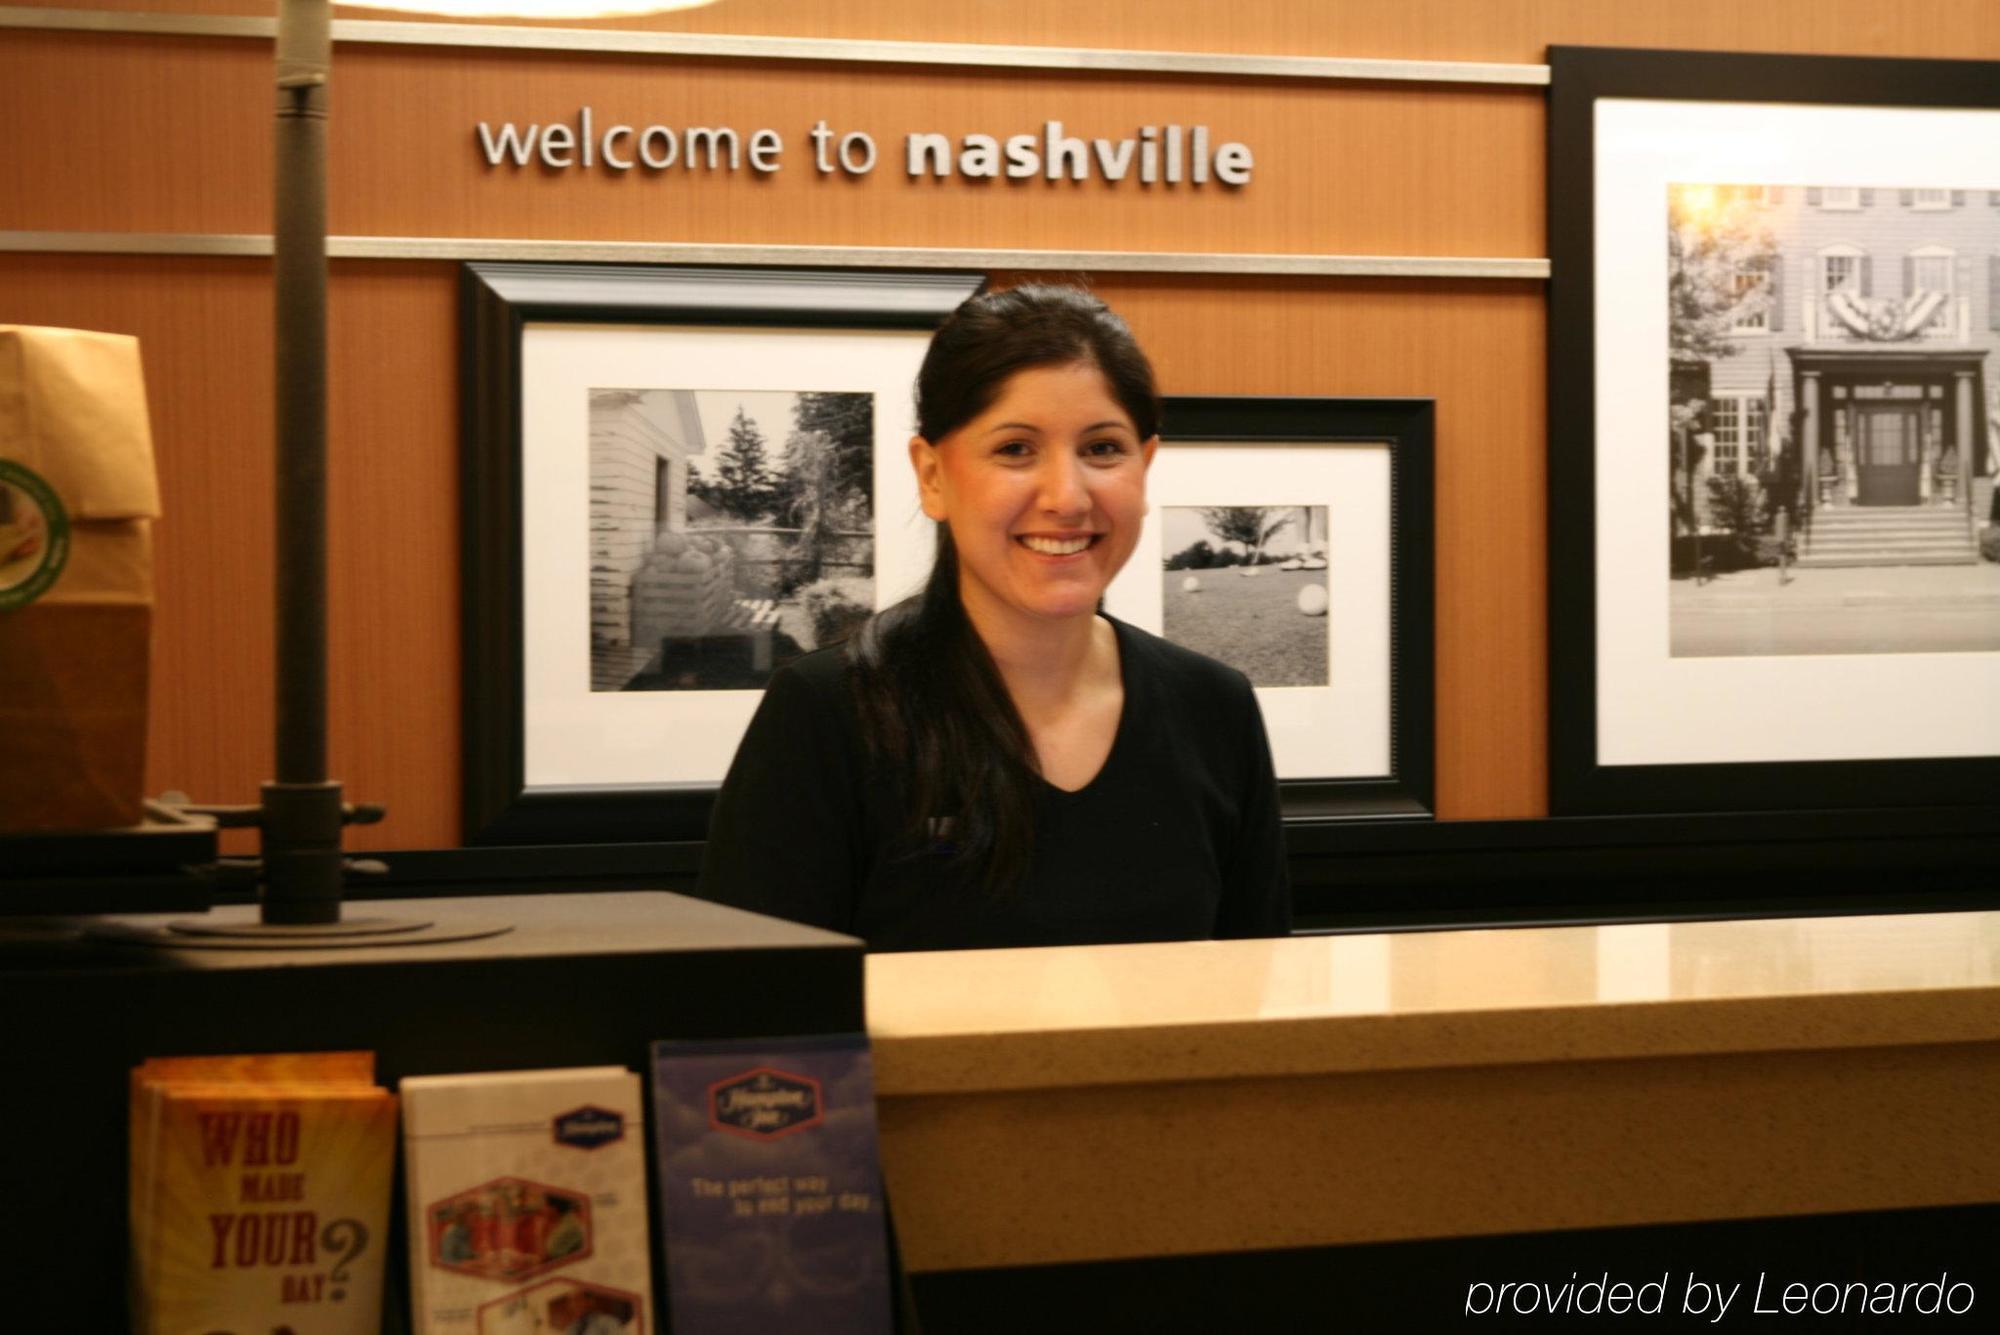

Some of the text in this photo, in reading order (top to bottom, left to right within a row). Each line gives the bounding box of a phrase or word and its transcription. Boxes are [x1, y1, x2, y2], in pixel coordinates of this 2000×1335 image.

[477, 107, 1254, 186] welcome to nashville
[198, 1111, 300, 1168] WHO
[240, 1173, 305, 1203] MADE
[207, 1211, 318, 1270] YOUR
